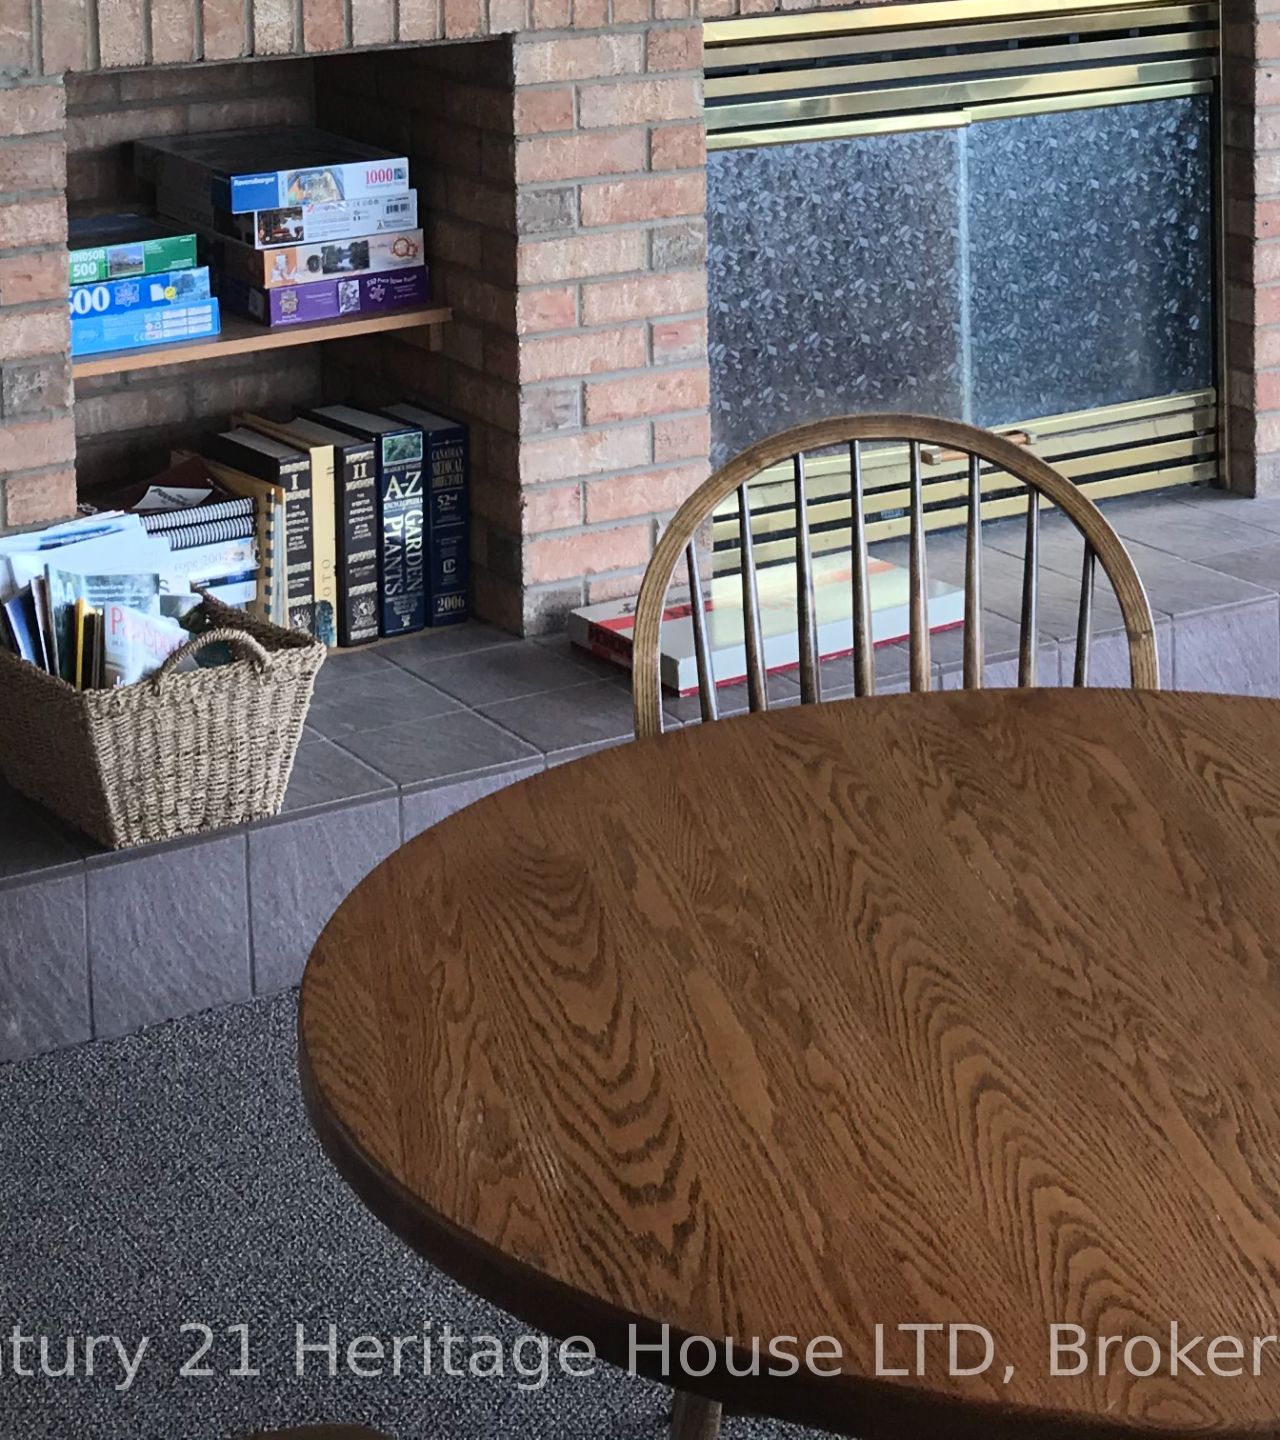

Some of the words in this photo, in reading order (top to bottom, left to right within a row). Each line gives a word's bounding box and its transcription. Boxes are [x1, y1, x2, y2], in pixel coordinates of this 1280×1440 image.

[366, 167, 393, 185] 1000
[73, 262, 97, 278] 500
[431, 446, 465, 461] CANADIAN
[352, 462, 368, 480] II
[431, 460, 465, 475] MEDICAL
[291, 473, 299, 491] I
[382, 471, 424, 502] A-Z
[383, 513, 404, 605] PLANTS
[404, 510, 424, 592] GARDEN
[437, 595, 466, 613] 2006
